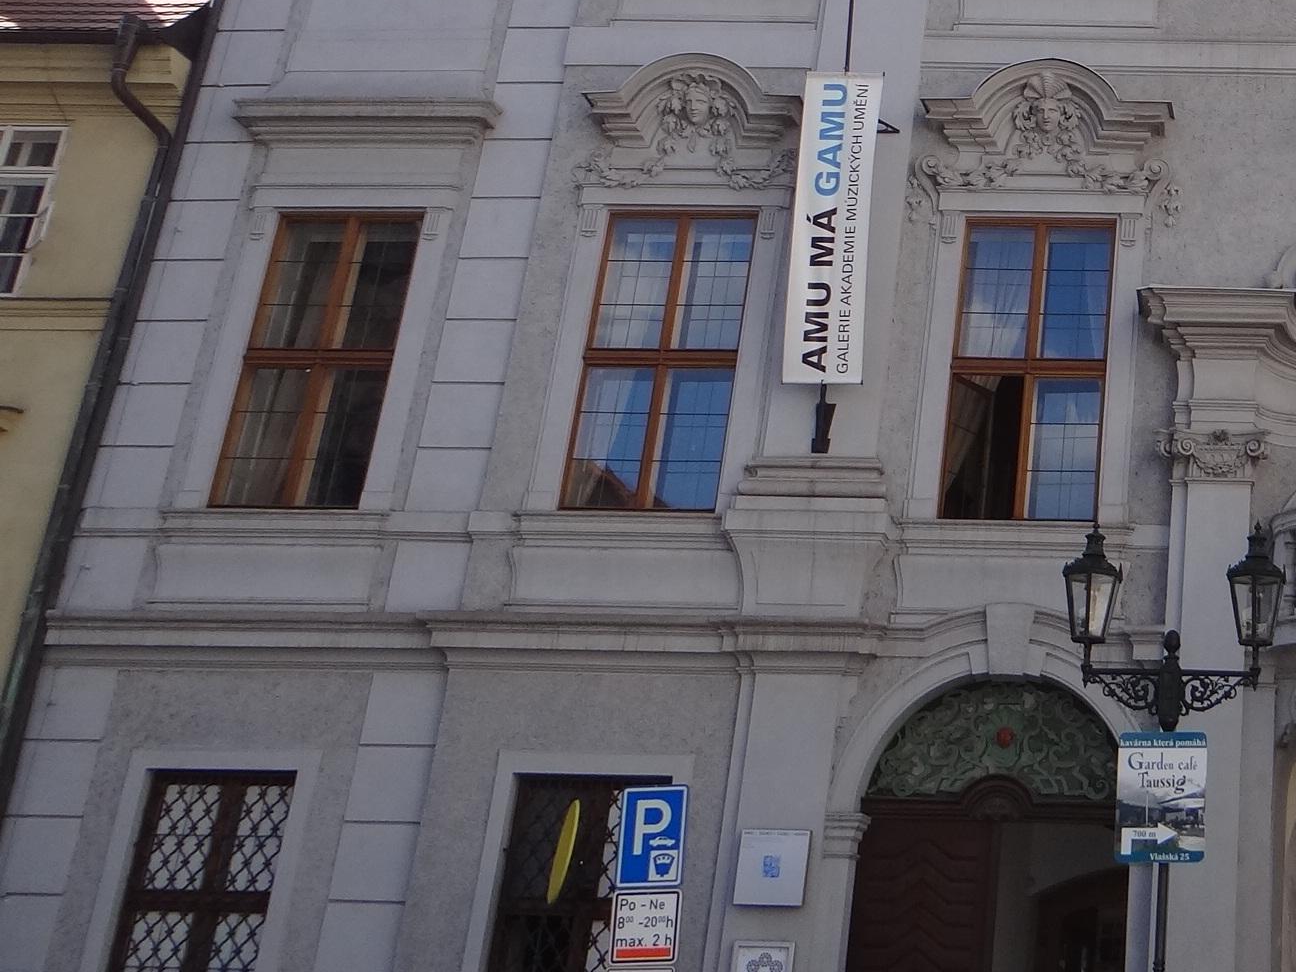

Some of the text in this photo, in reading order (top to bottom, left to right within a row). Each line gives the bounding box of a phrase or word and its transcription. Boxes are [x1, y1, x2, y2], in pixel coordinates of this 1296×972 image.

[802, 83, 849, 373] AMU MÁ GAMU
[836, 83, 870, 375] GALERIE AKADEMIE MÚZICKÝCH UMĚNÍ
[1128, 751, 1174, 771] Garden
[1138, 771, 1186, 794] Taussig
[633, 799, 672, 855] P
[619, 898, 636, 911] Po
[649, 899, 665, 910] Ne
[616, 933, 672, 947] max. 2 h
